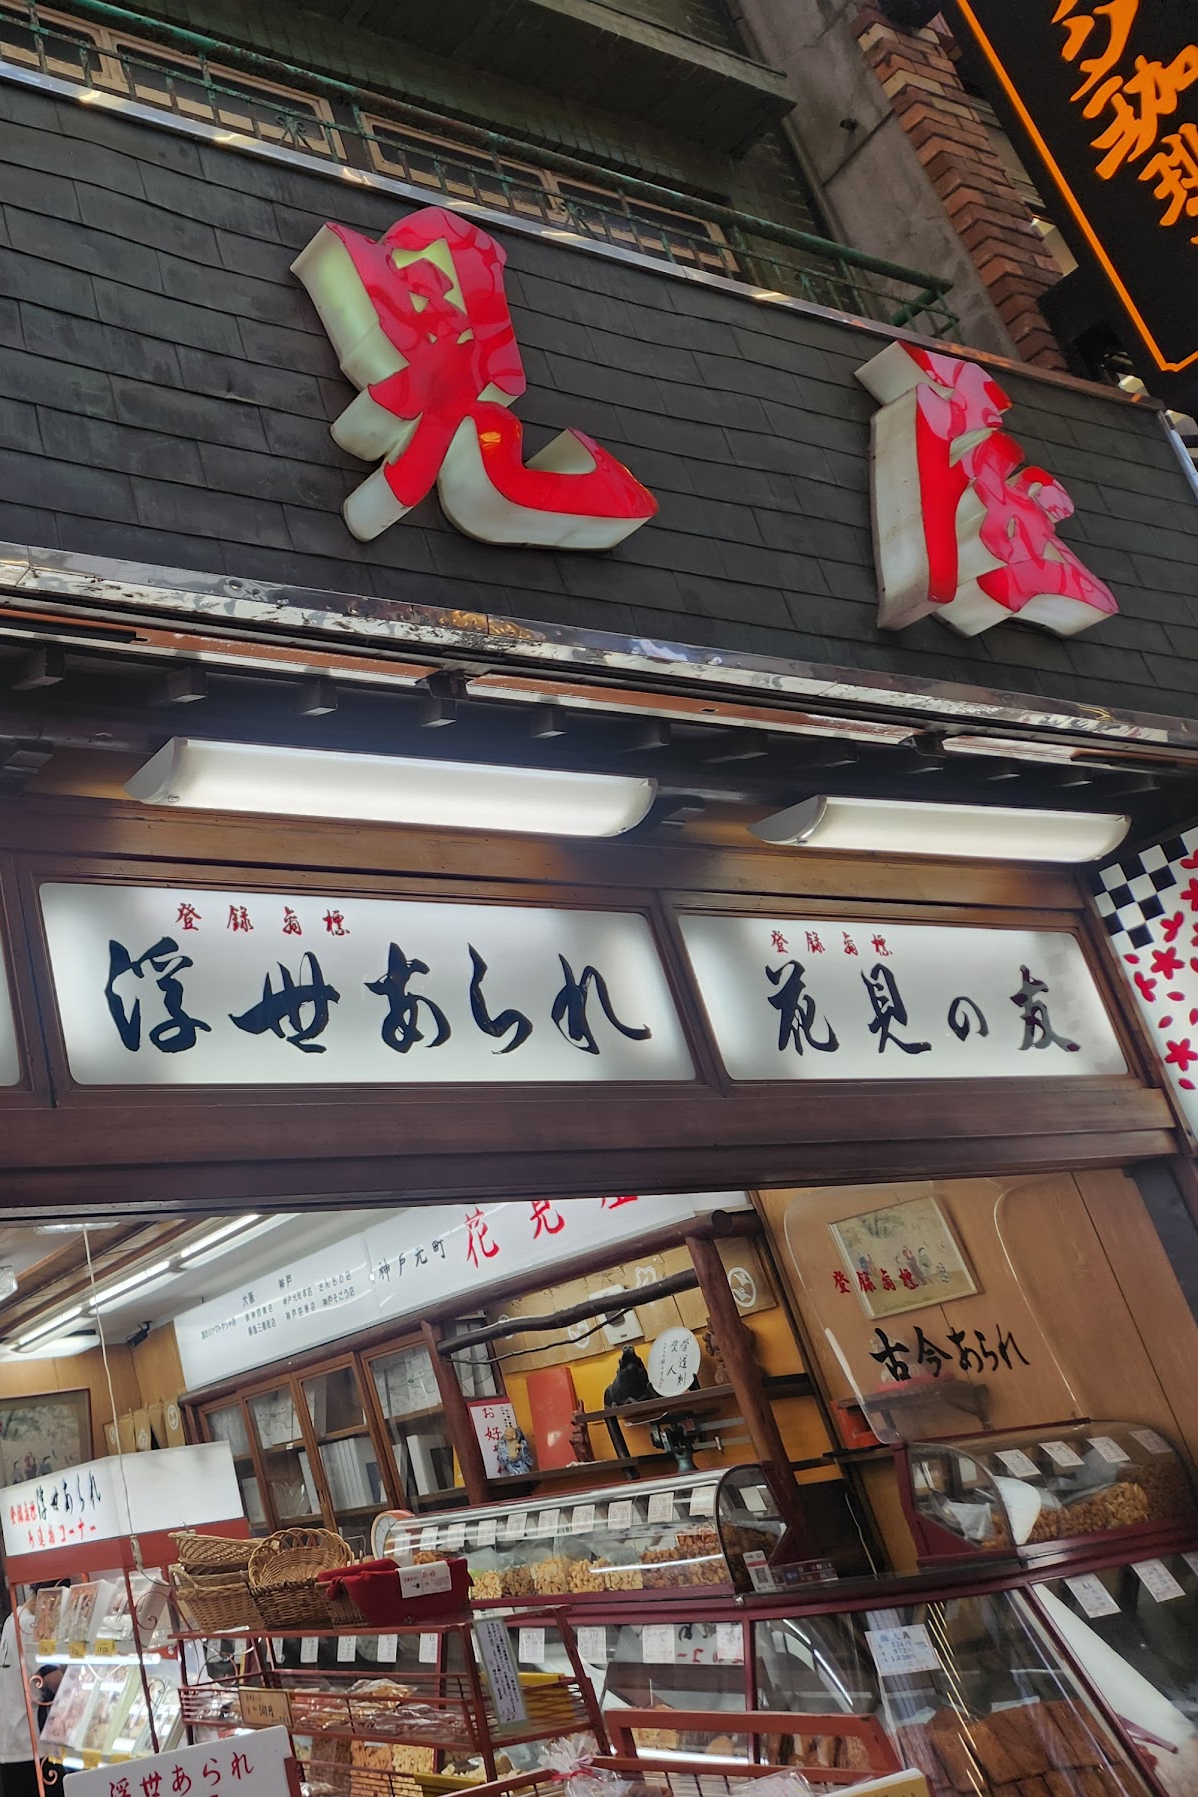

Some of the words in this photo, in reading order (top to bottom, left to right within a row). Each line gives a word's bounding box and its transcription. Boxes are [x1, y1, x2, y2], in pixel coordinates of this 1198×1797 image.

[104, 936, 653, 1055] 浮世あられ
[765, 960, 1082, 1055] 花見の友
[278, 1274, 292, 1290] 神戸
[378, 1239, 446, 1282] 神戸元町
[869, 1324, 1030, 1382] 古今あられ
